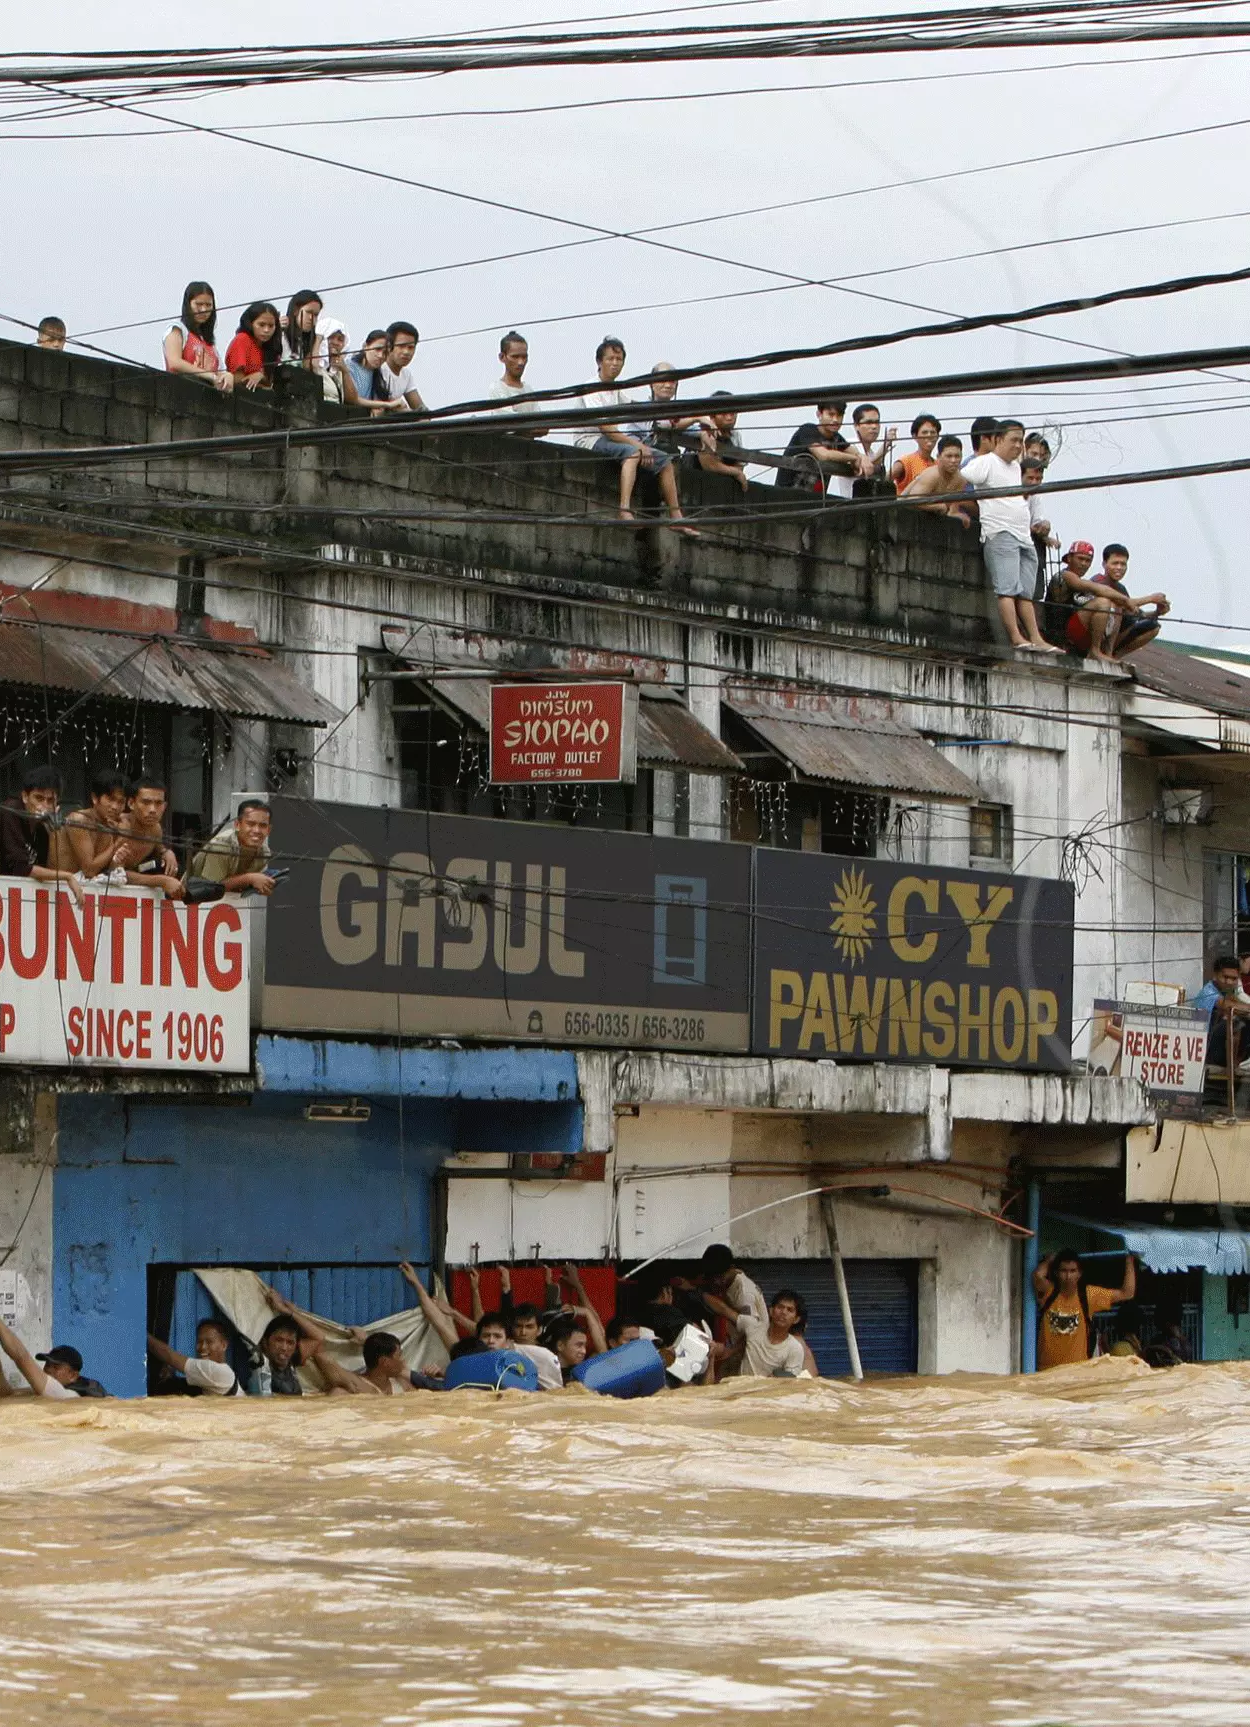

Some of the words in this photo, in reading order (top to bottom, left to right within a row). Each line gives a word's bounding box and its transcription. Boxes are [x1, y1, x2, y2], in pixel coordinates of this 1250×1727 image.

[520, 700, 593, 716] DIMSUM
[545, 690, 570, 699] JJW
[503, 718, 610, 747] SIOPAO
[511, 753, 556, 765] FACTORY
[565, 751, 602, 764] OUTLET
[531, 768, 582, 778] 656-3780
[320, 844, 584, 977] GASUL
[887, 876, 1013, 968] CY
[565, 1011, 629, 1036] 656-0335
[633, 1015, 639, 1037] /
[642, 1016, 705, 1042] 656-3286
[769, 969, 1058, 1064] PAWNSHOP
[68, 1006, 151, 1059] SINCE
[162, 1011, 224, 1063] 1906
[1125, 1030, 1169, 1059] RENZE
[1173, 1035, 1182, 1060] &
[1186, 1036, 1204, 1062] VE
[1140, 1060, 1185, 1086] STORE
